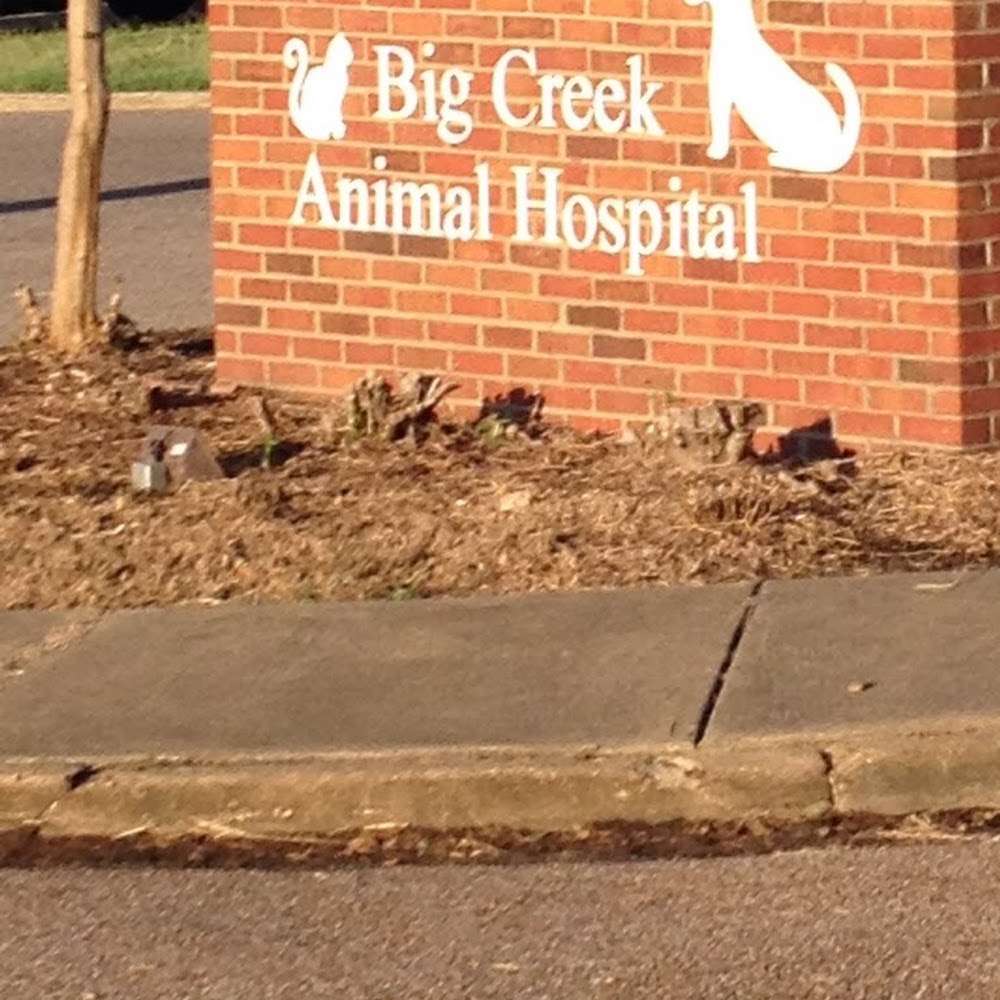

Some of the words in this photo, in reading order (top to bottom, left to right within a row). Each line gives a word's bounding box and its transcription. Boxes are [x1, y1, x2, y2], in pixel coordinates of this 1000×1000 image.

[372, 42, 473, 144] Big
[493, 48, 666, 136] Creek
[290, 153, 493, 241] Animal
[511, 166, 761, 276] Hospital
